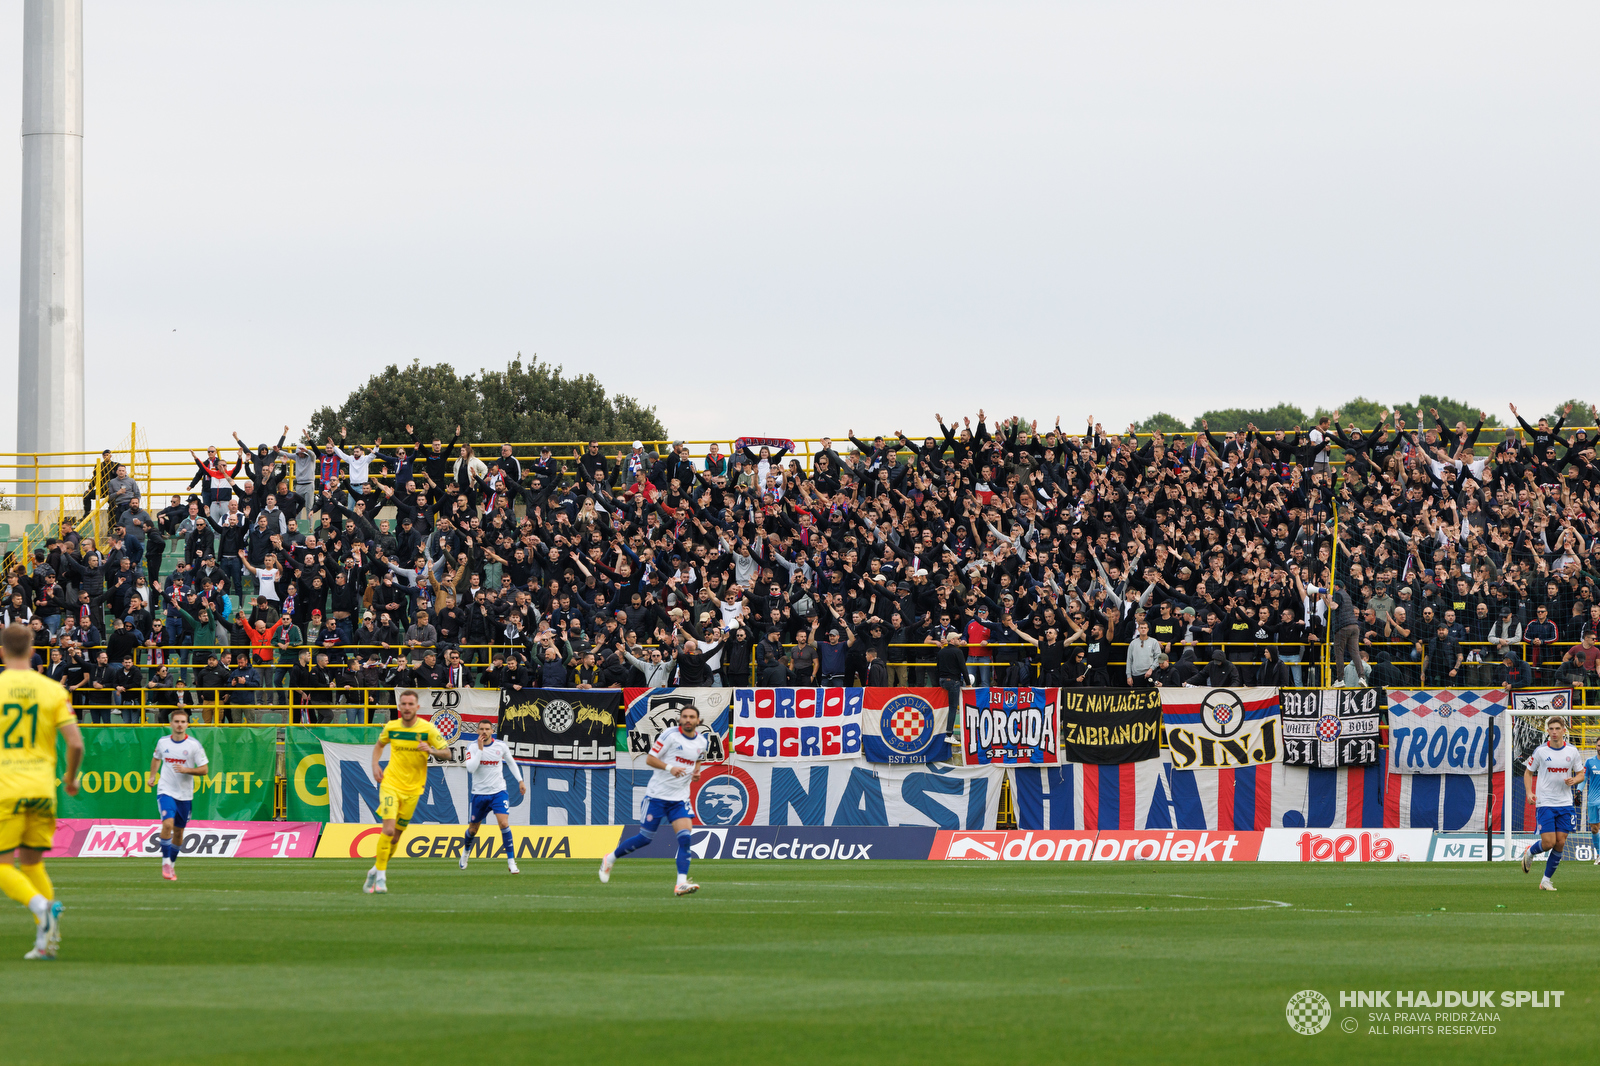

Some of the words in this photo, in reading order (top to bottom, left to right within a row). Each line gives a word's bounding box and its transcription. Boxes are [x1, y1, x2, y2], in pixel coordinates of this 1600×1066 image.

[431, 690, 460, 707] ZD
[735, 687, 863, 718] TORCIDA
[888, 698, 929, 713] HAJDUK
[1066, 692, 1083, 711] UZ
[1147, 689, 1161, 708] SA
[3, 703, 38, 748] 21
[965, 702, 1055, 755] TORCIDA
[1066, 721, 1157, 746] ZABRANOM
[1285, 724, 1311, 734] WHITE
[735, 723, 861, 757] ZAGREB
[889, 737, 923, 750] SPLIT
[1168, 719, 1277, 769] SINJ
[1393, 725, 1501, 768] TROGIR
[888, 755, 907, 764] EST.
[909, 755, 927, 763] 1911
[986, 748, 1034, 759] SPLIT
[87, 830, 239, 855] MAXSORT
[406, 836, 571, 858] GERMANIA
[732, 838, 873, 860] Electrolux
[1296, 832, 1395, 862] topla
